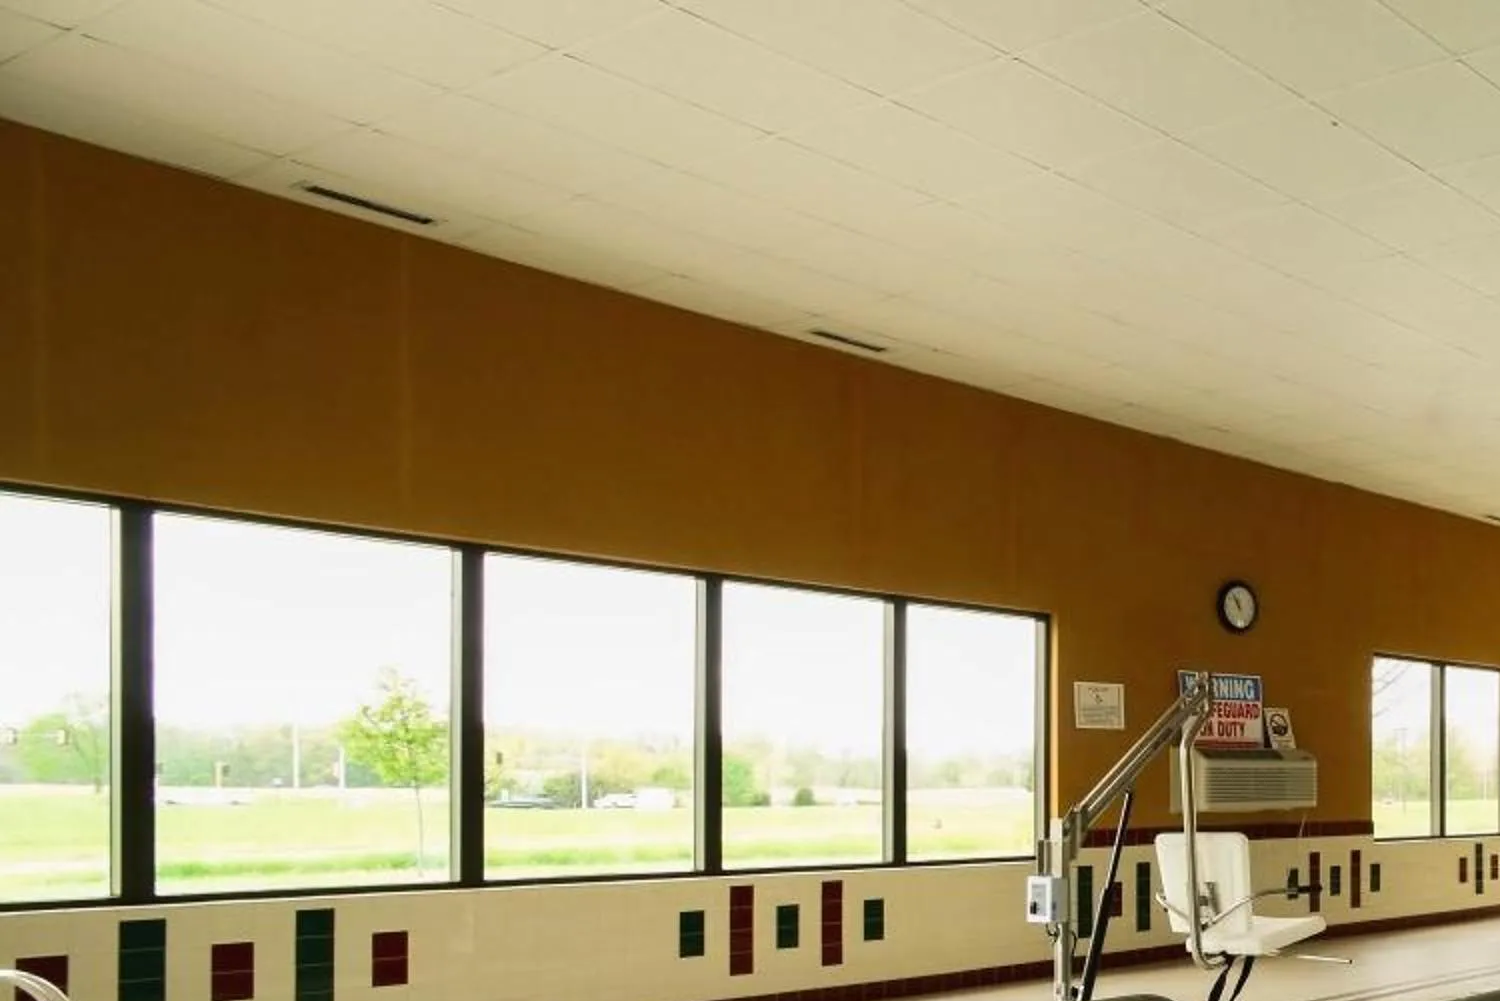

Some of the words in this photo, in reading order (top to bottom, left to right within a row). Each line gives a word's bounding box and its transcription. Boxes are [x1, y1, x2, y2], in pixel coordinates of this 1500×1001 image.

[1184, 676, 1255, 700] WRNING
[1211, 701, 1261, 719] FEGUARD
[1217, 721, 1246, 738] DUTY
